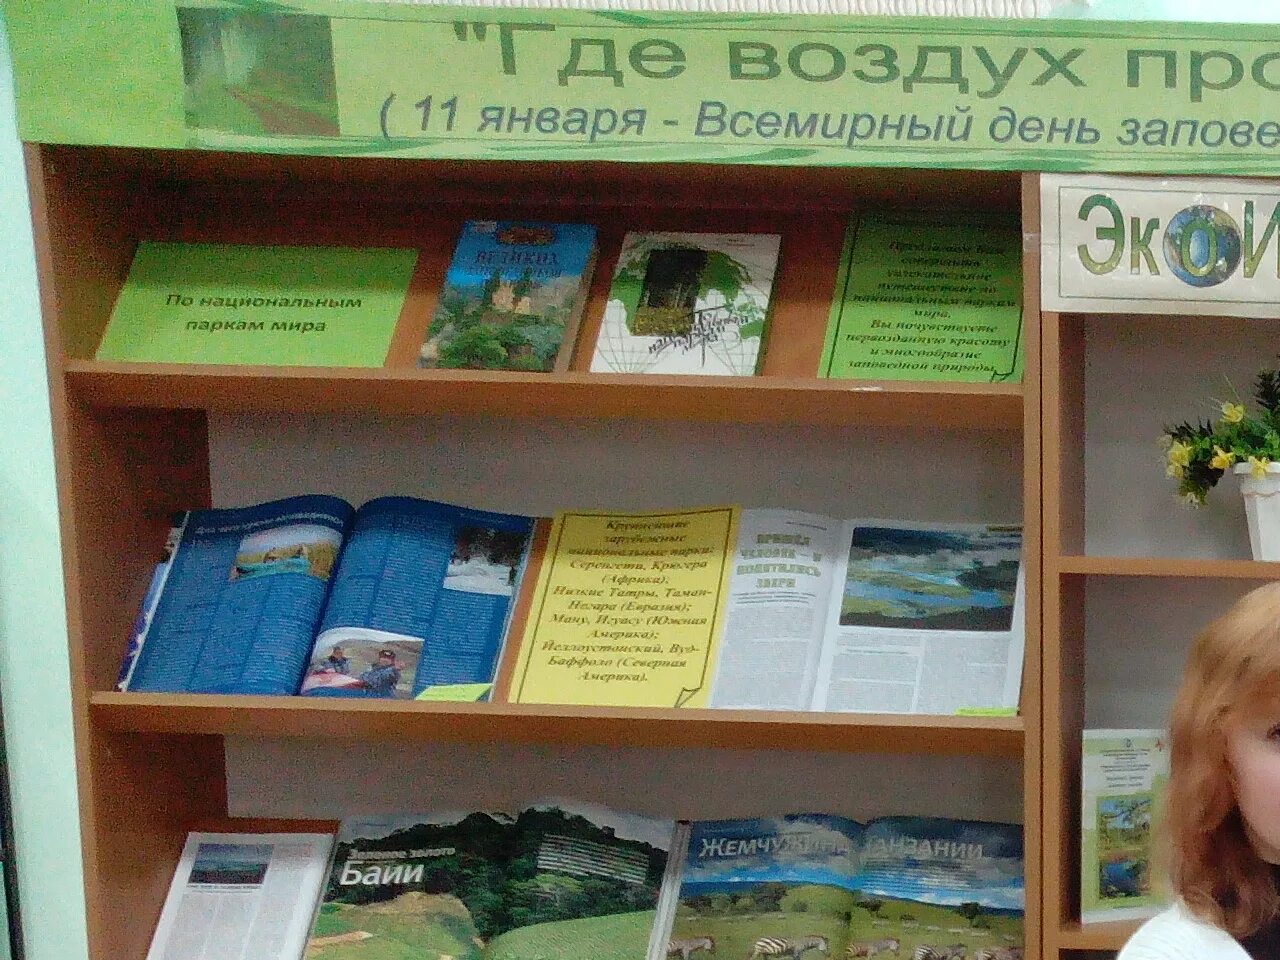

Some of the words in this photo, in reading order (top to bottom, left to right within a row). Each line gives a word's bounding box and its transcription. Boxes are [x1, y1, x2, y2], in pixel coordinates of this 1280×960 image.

[453, 21, 686, 87] "Где
[728, 40, 1086, 98] воздух
[415, 97, 459, 132] 11
[476, 104, 647, 139] января
[694, 101, 975, 148] Всемирный
[989, 106, 1101, 147] день
[165, 292, 195, 308] По
[200, 294, 363, 312] национальным
[185, 317, 266, 335] паркам
[273, 319, 328, 335] мира
[552, 585, 605, 597] Низкие
